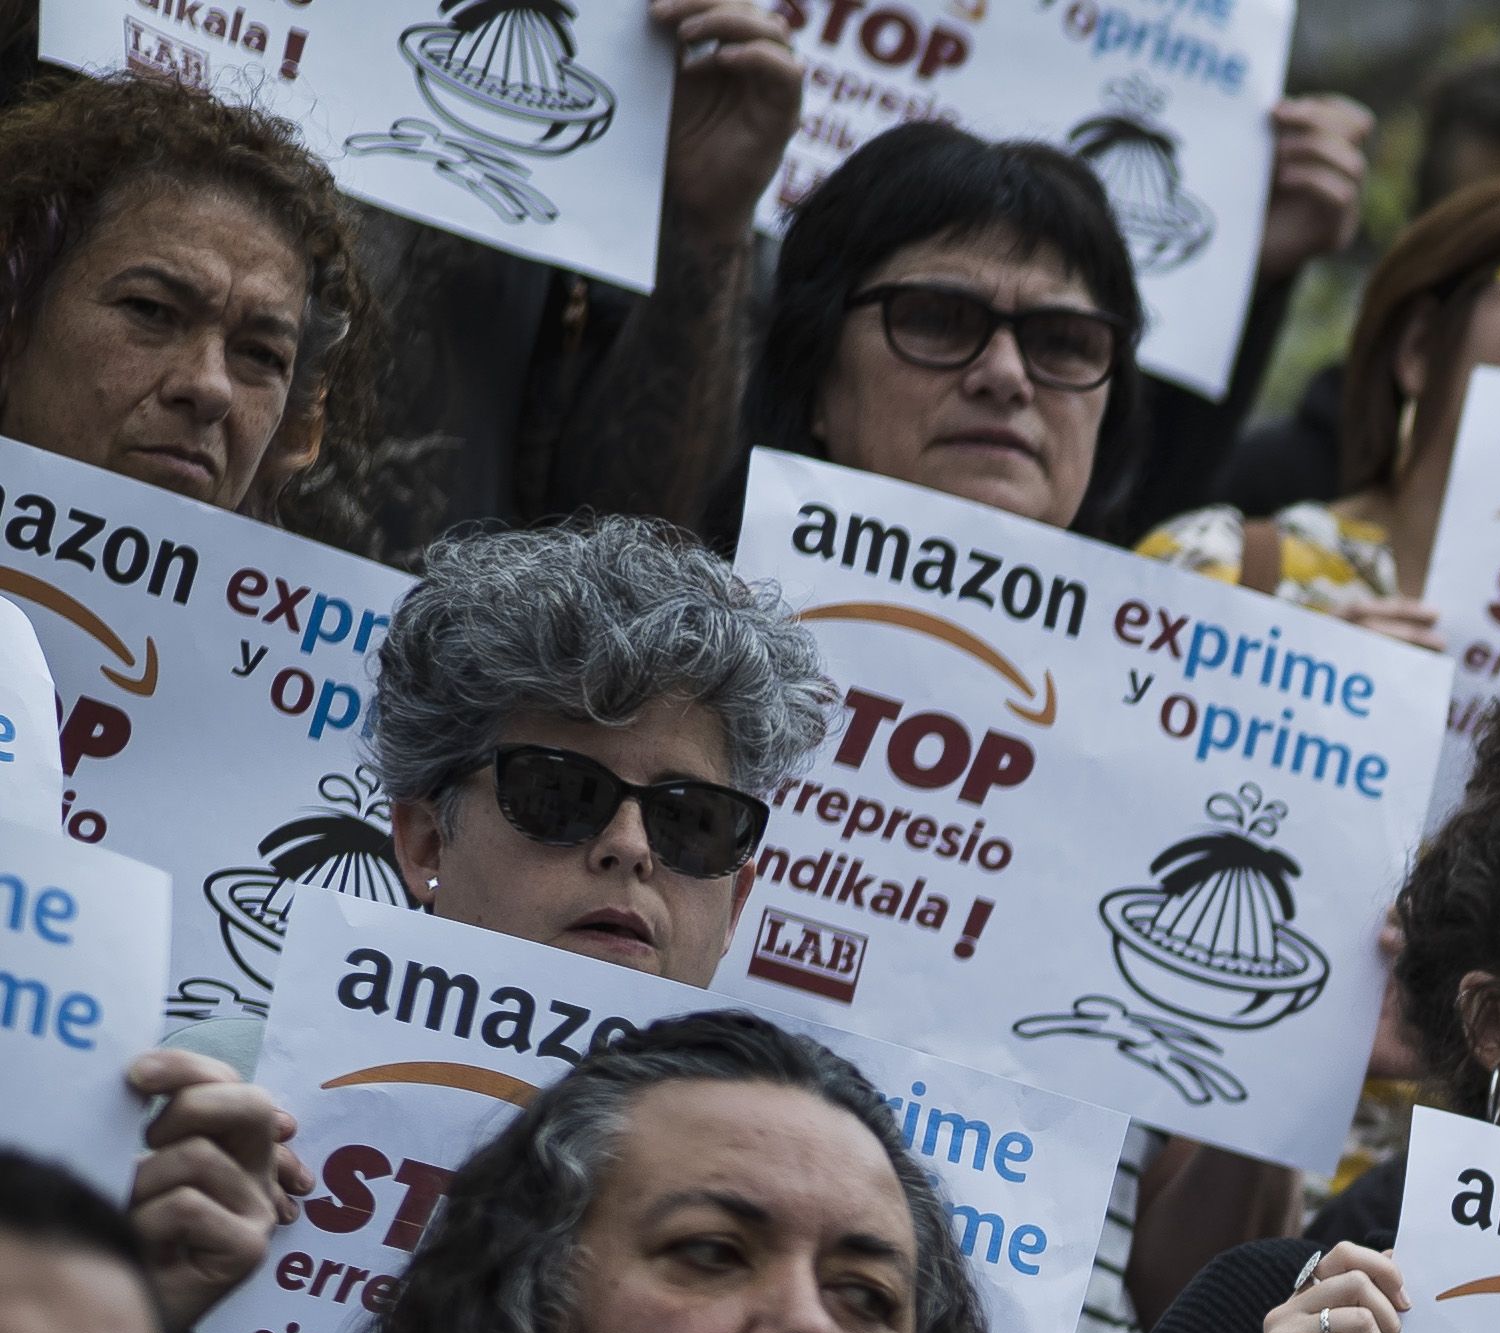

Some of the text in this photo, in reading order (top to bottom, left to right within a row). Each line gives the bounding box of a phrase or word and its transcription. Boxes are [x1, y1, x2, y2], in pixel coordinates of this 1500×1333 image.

[780, 0, 969, 80] TOP
[0, 487, 391, 657] azon expr
[791, 502, 1085, 634] amazon
[1115, 602, 1373, 713] exprime
[834, 685, 1036, 809] TOP
[1122, 670, 1154, 704] y
[1160, 674, 1386, 793] oprime
[771, 775, 1014, 873] rrepresio
[756, 842, 997, 960] ndikala!
[761, 918, 859, 975] LAB
